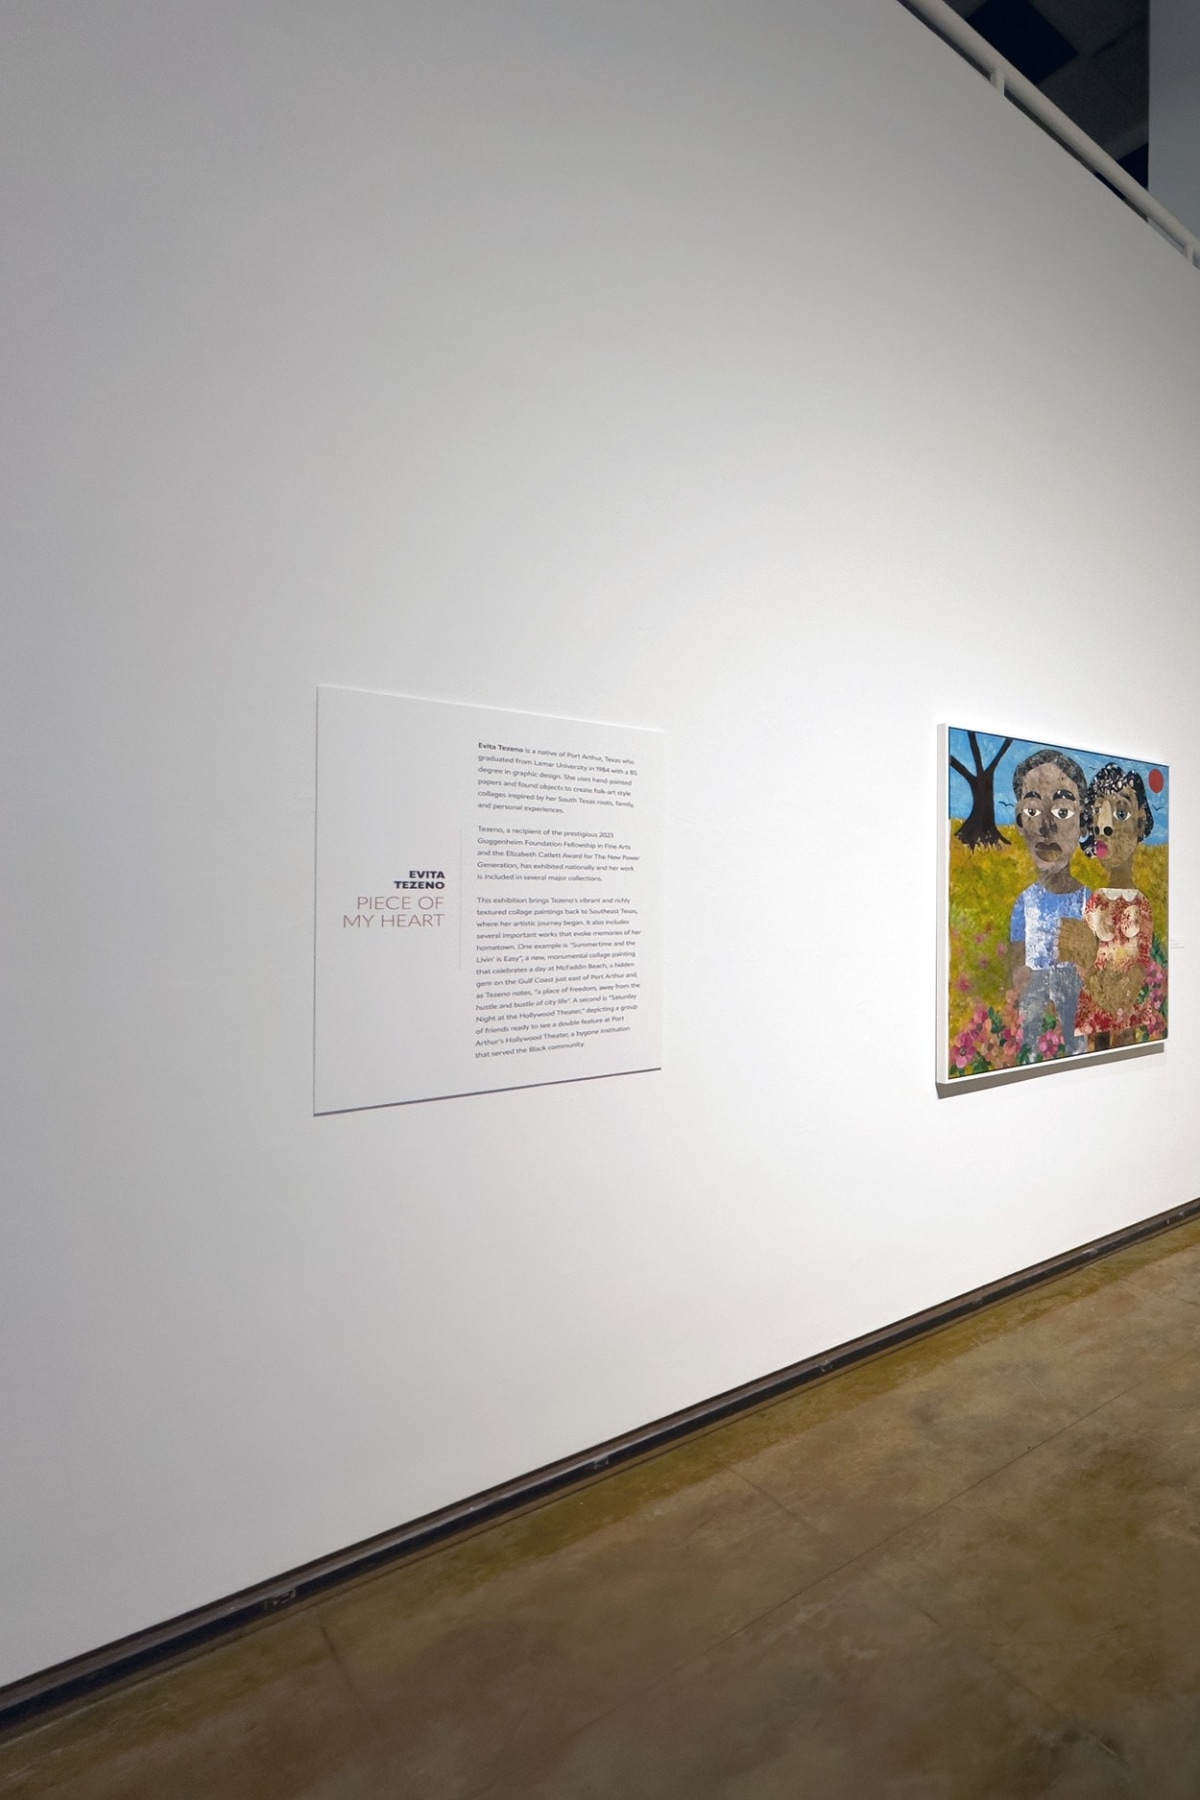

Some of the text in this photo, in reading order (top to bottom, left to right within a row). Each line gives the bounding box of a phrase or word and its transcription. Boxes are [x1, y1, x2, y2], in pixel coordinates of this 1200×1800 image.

[478, 743, 497, 751] Evita
[497, 744, 523, 754] Tezeno
[478, 756, 514, 765] graduated
[534, 760, 555, 768] Lamar
[556, 762, 587, 773] University
[478, 766, 503, 776] degree
[512, 771, 538, 779] graphic
[518, 781, 538, 789] found
[539, 783, 564, 792] objects
[478, 790, 506, 800] collages
[508, 792, 535, 801] inspired
[478, 826, 504, 834] Tezeno,
[512, 828, 541, 836] recipient
[564, 830, 598, 839] prestigious
[478, 838, 524, 847] Guggenheim
[524, 840, 562, 848] Foundation
[477, 861, 519, 870] Generation,
[409, 870, 445, 879] EVITA
[548, 874, 566, 883] major
[394, 880, 445, 890] TEZENO
[357, 896, 445, 910] PIECE OF
[528, 897, 549, 906] brings
[614, 898, 630, 906] richly
[508, 908, 533, 917] collage
[343, 914, 445, 928] MY HEART
[537, 920, 562, 928] journey
[502, 932, 537, 940] important
[534, 942, 561, 950] example
[589, 952, 611, 960] collage
[611, 951, 636, 960] painting
[534, 965, 547, 973] day
[542, 988, 560, 996] place
[544, 999, 556, 1007] city
[476, 1015, 496, 1024] Night
[519, 1010, 555, 1020] Hollywood
[485, 1025, 509, 1034] friends
[510, 1024, 529, 1032] ready
[506, 1033, 542, 1044] Hollywood
[491, 1048, 515, 1057] served
[529, 1045, 546, 1053] Black
